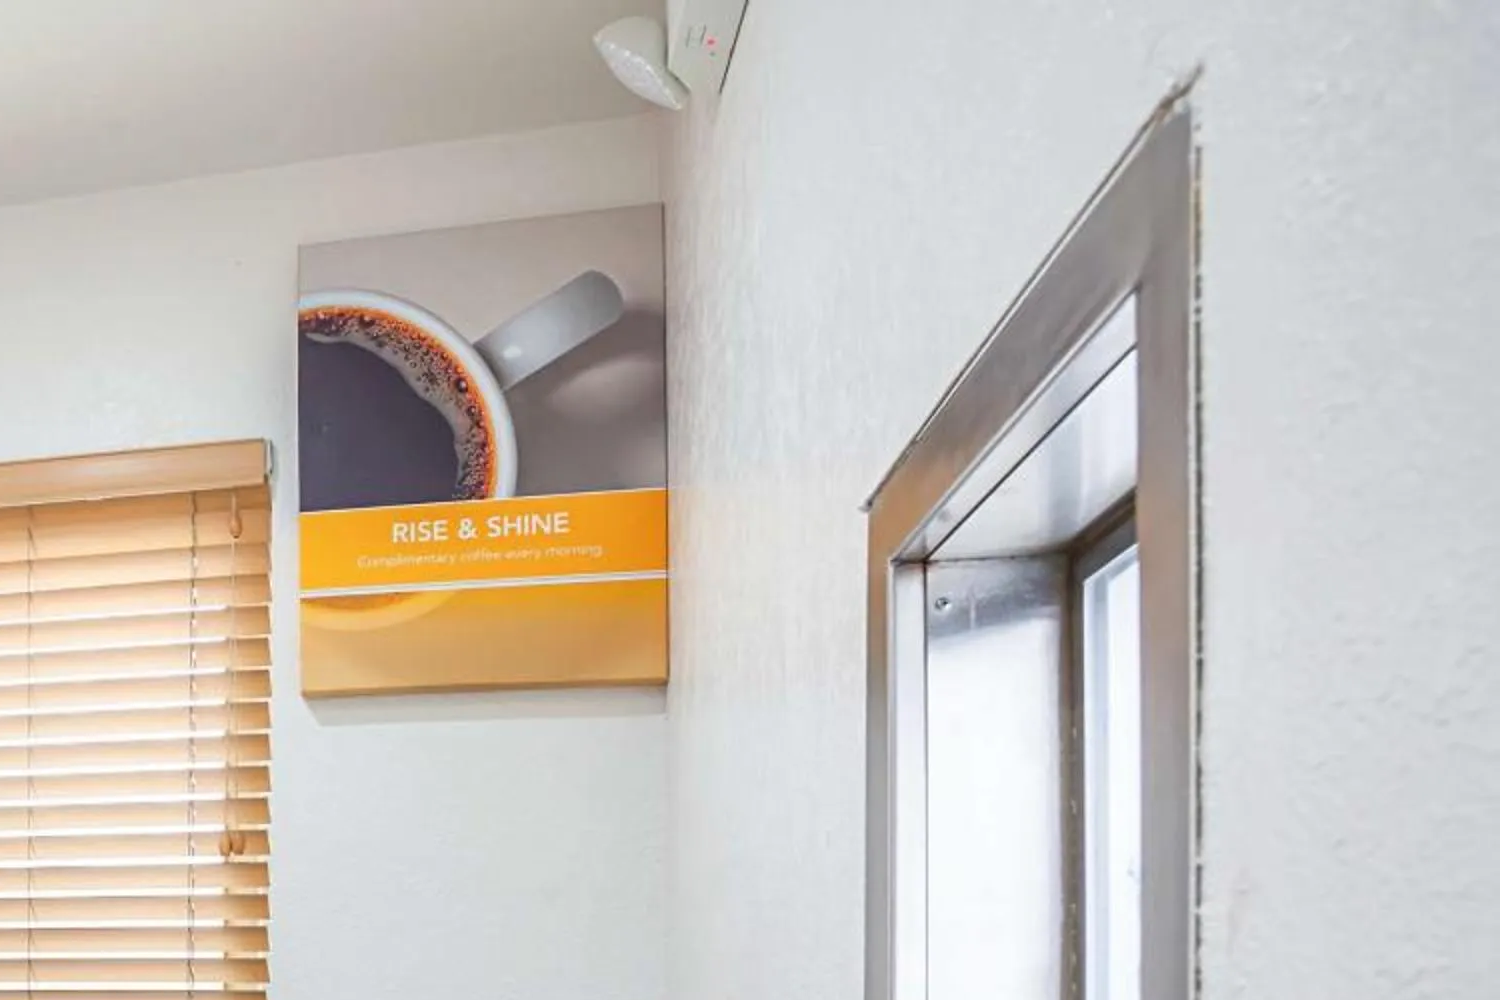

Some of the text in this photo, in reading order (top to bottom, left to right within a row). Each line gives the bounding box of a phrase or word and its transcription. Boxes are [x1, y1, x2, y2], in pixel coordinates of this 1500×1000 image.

[392, 511, 571, 543] RISE & SHINE
